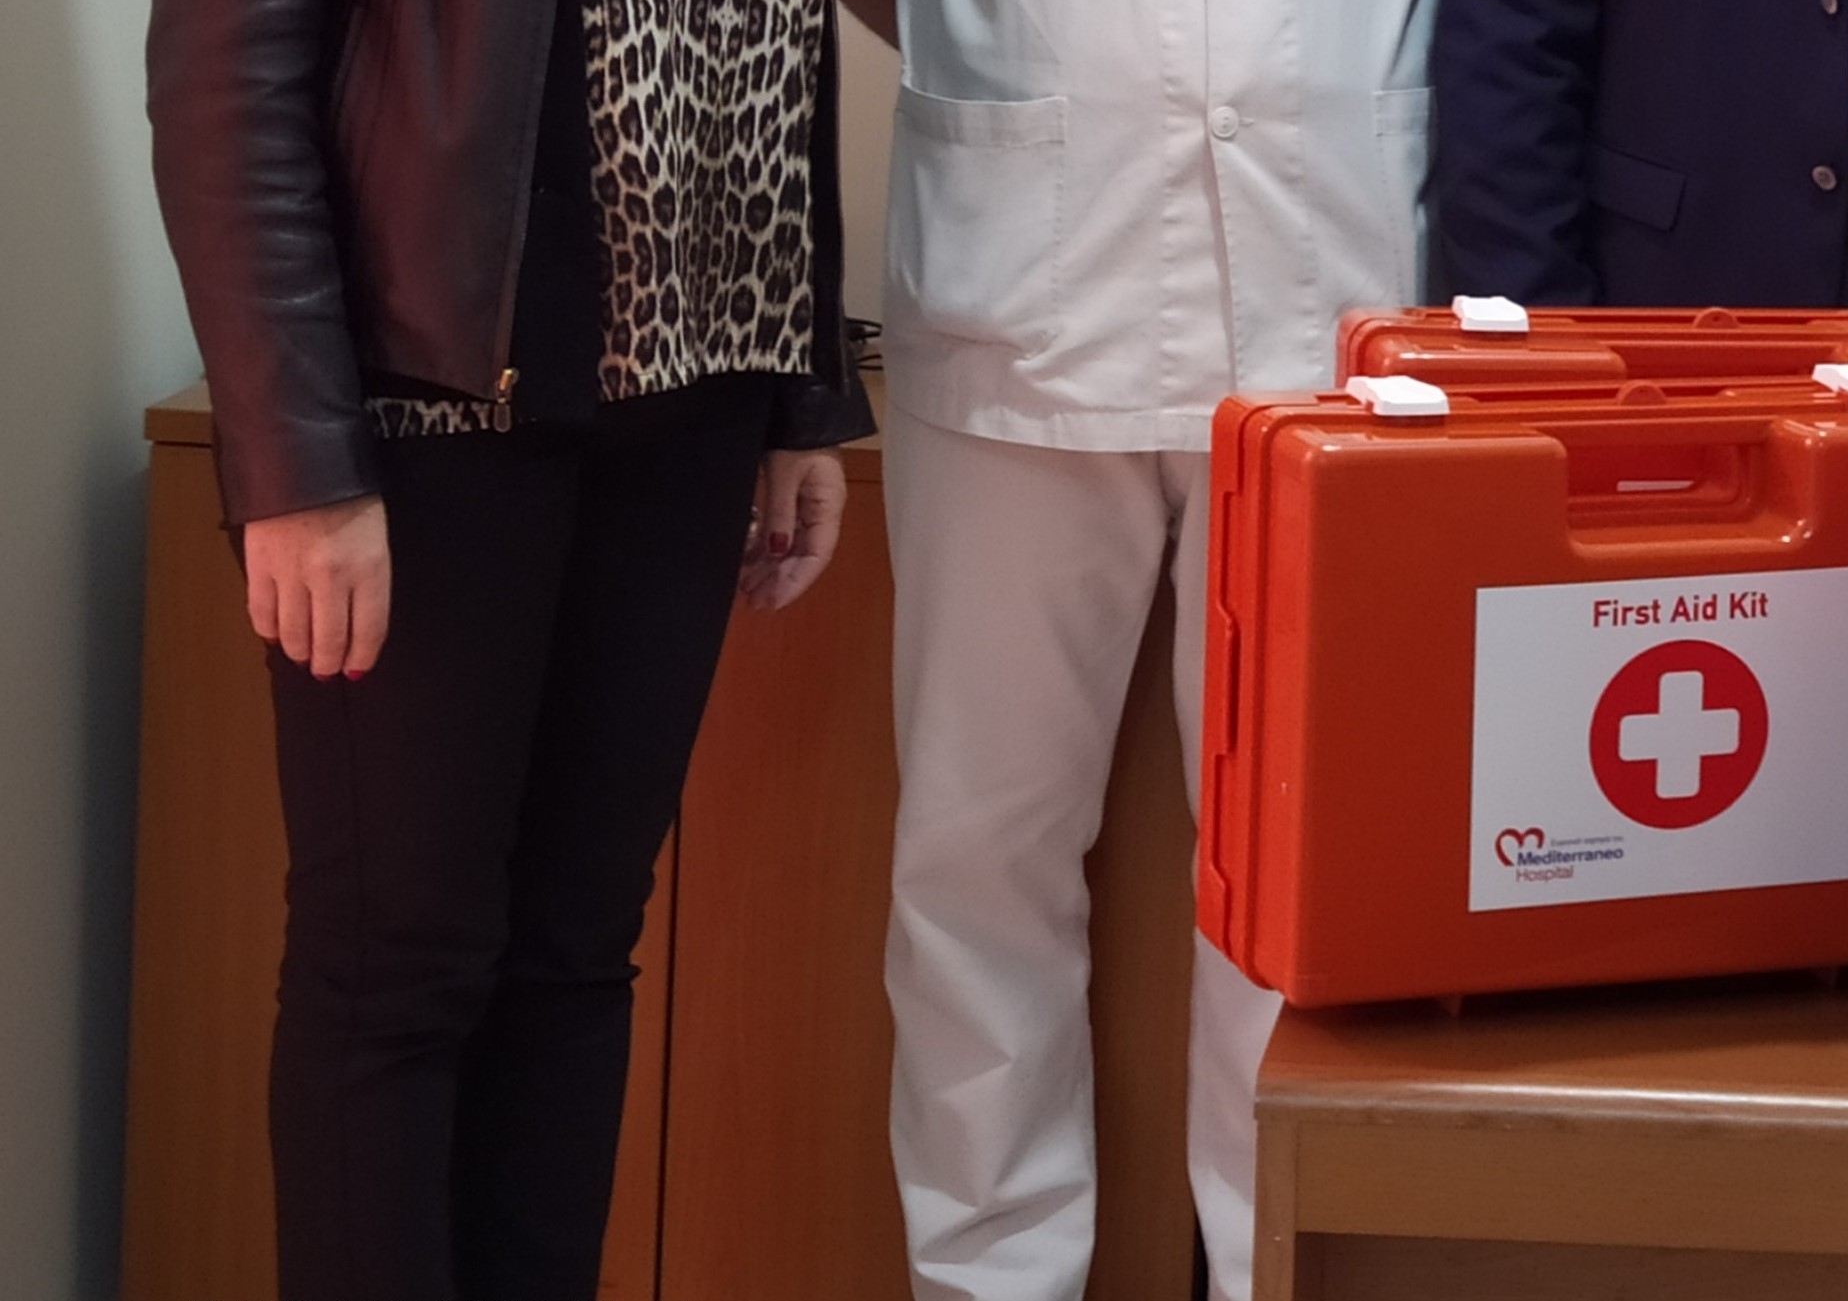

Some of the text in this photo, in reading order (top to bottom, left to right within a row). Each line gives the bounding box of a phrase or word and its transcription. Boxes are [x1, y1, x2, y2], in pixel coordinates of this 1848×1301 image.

[1593, 591, 1768, 628] First Aid Kit
[1517, 848, 1624, 866] Mediterraneo
[1516, 865, 1574, 883] Hospital
